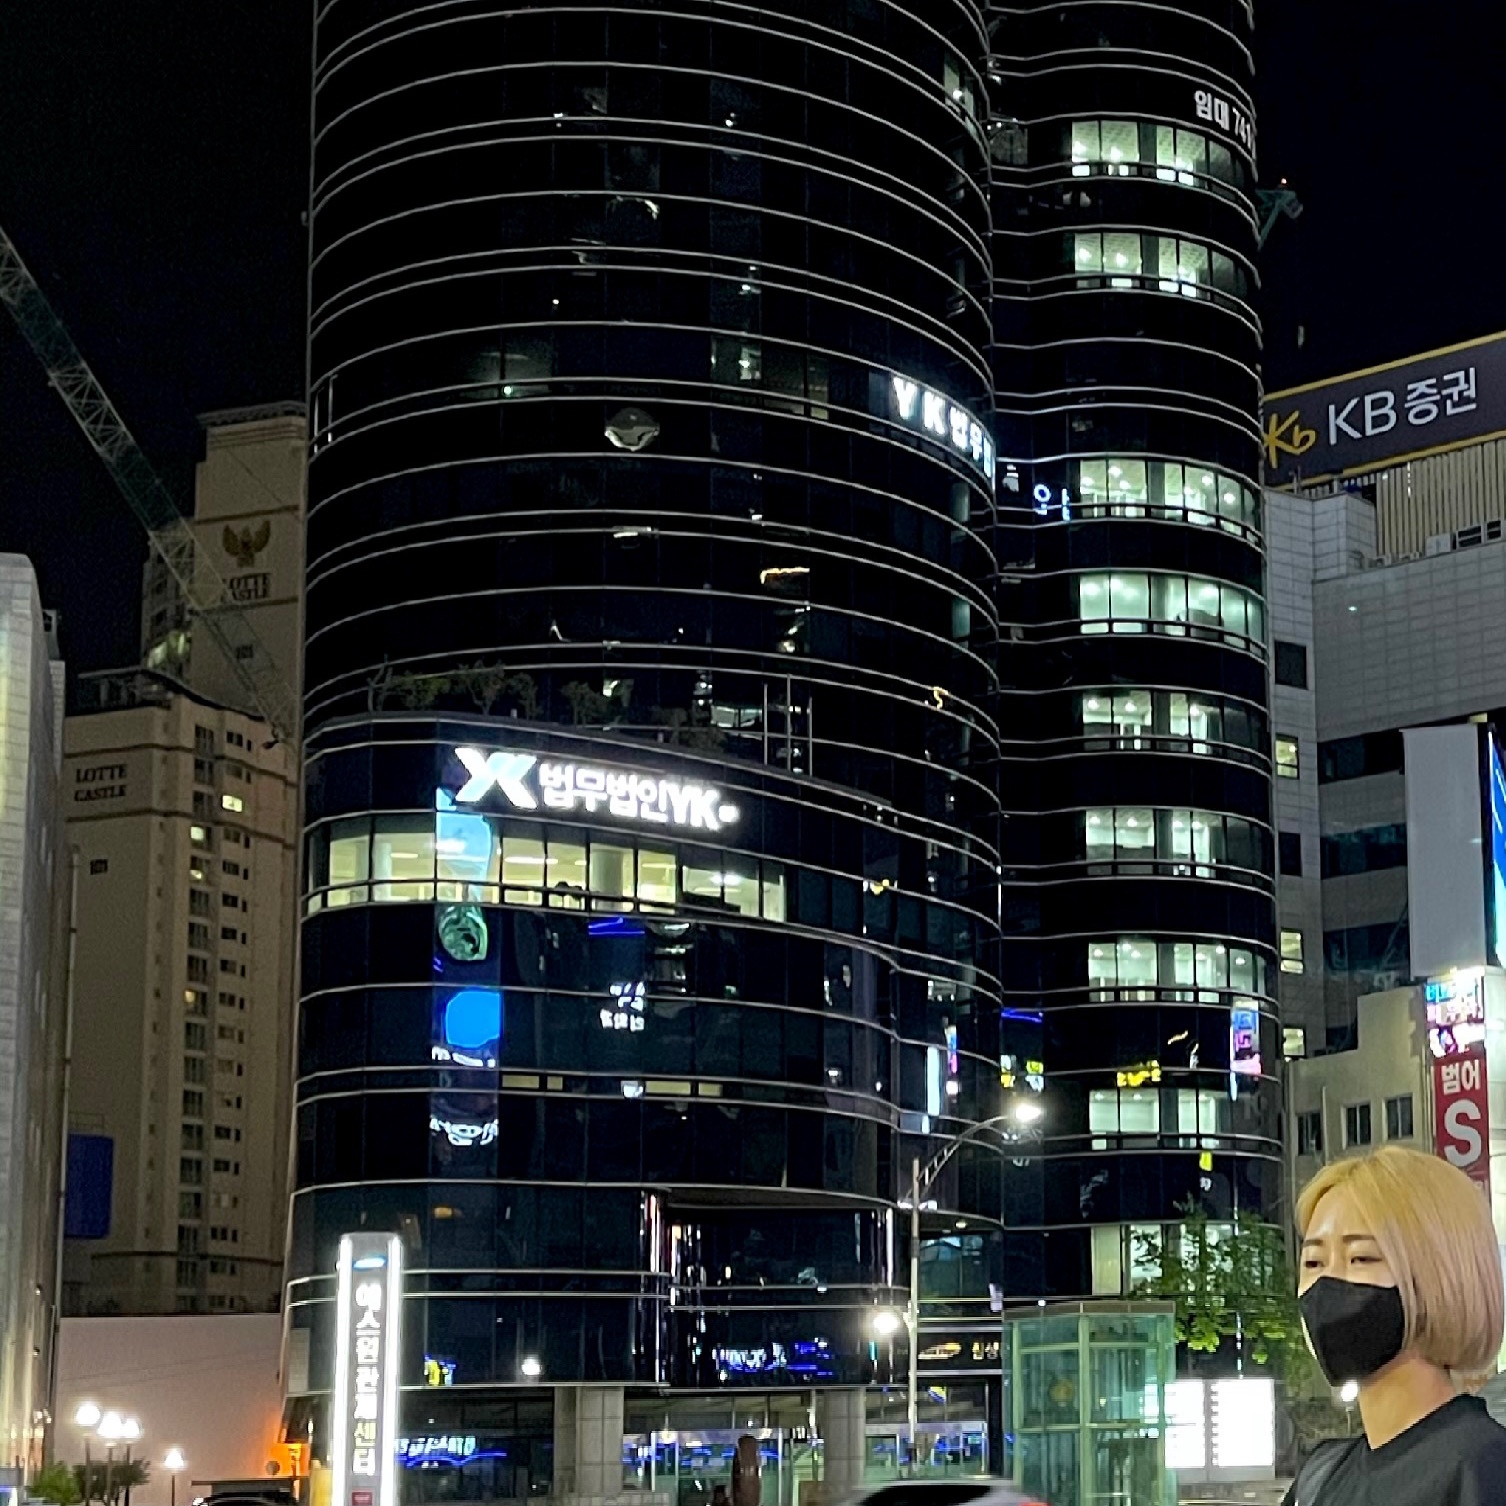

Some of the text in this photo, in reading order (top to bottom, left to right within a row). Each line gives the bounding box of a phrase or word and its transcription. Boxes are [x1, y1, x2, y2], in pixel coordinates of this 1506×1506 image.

[1194, 90, 1230, 131] 임대
[76, 764, 128, 783] LOTTE
[74, 785, 127, 802] CASTLE
[1441, 1059, 1481, 1096] 범어
[1443, 1099, 1482, 1167] S
